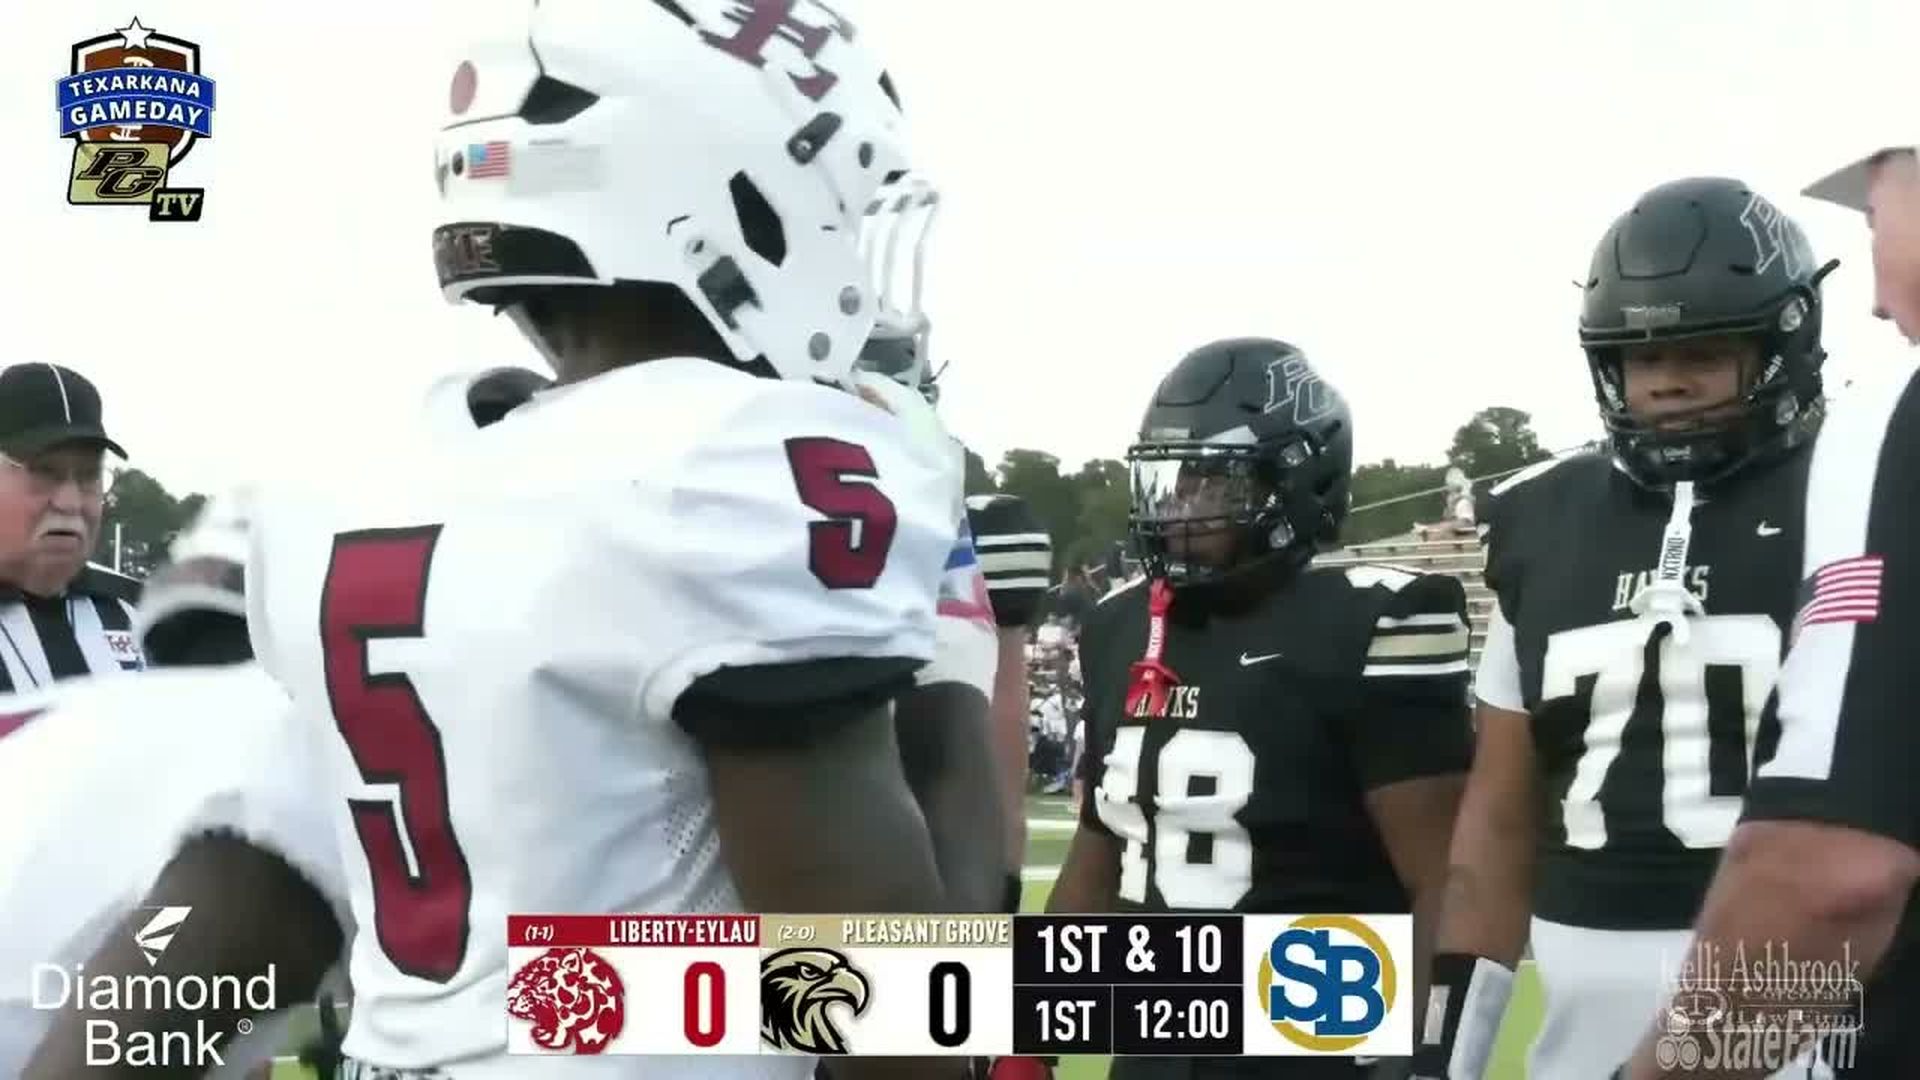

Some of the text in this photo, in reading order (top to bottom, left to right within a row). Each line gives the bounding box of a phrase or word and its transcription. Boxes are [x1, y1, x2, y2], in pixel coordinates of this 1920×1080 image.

[783, 435, 898, 590] 5
[1612, 565, 1711, 611] HAS
[320, 523, 472, 985] 5
[1541, 613, 1783, 850] 70
